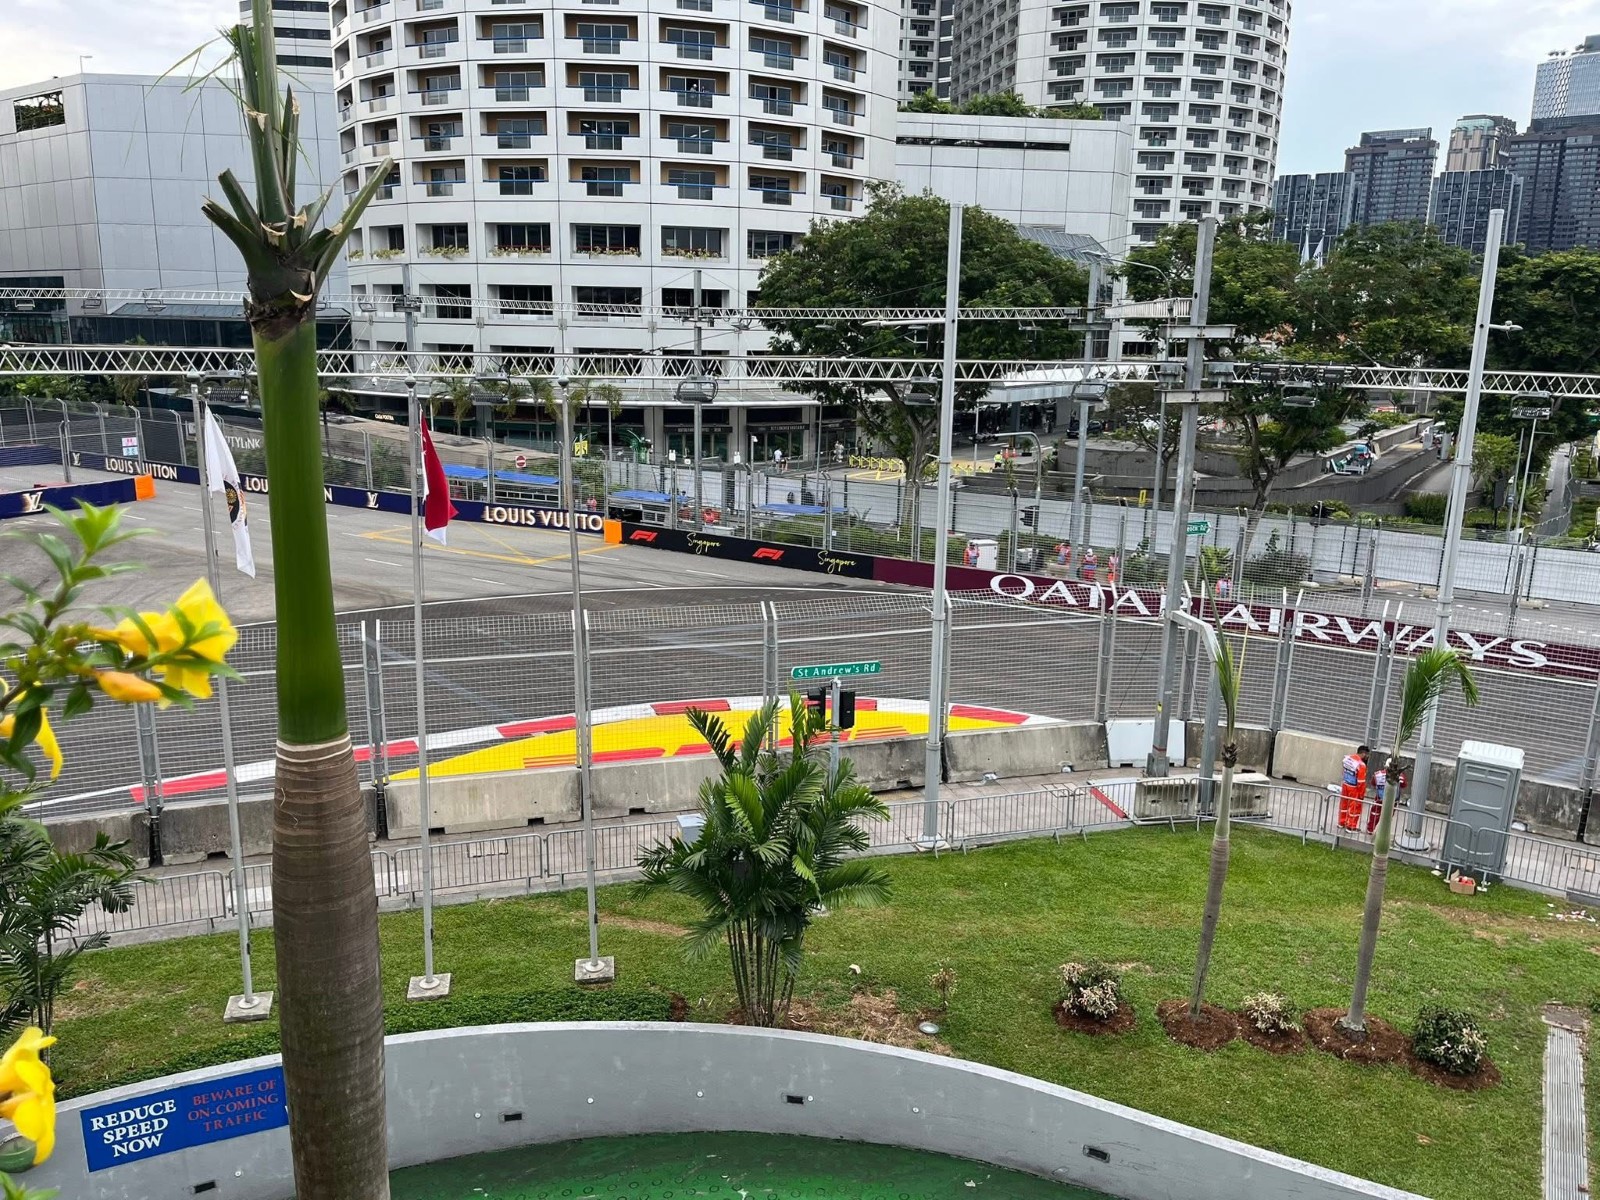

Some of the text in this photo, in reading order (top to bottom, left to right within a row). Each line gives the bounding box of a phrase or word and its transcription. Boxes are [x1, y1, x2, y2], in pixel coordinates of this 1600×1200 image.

[105, 457, 134, 474] LOUIS
[245, 476, 269, 493] LOU
[484, 505, 603, 531] LOUIS VUITTO
[686, 532, 721, 555] Singapore
[817, 550, 857, 574] Singapore
[1218, 603, 1548, 669] AIRWAYS
[797, 663, 876, 677] St Andrew's Rd
[192, 1079, 278, 1106] BEWARE OF
[90, 1099, 177, 1132] REDUCE
[187, 1093, 279, 1122] ON-COMING
[103, 1117, 169, 1145] SPEED
[203, 1108, 267, 1132] TRAFFIC
[111, 1134, 163, 1158] NOW
